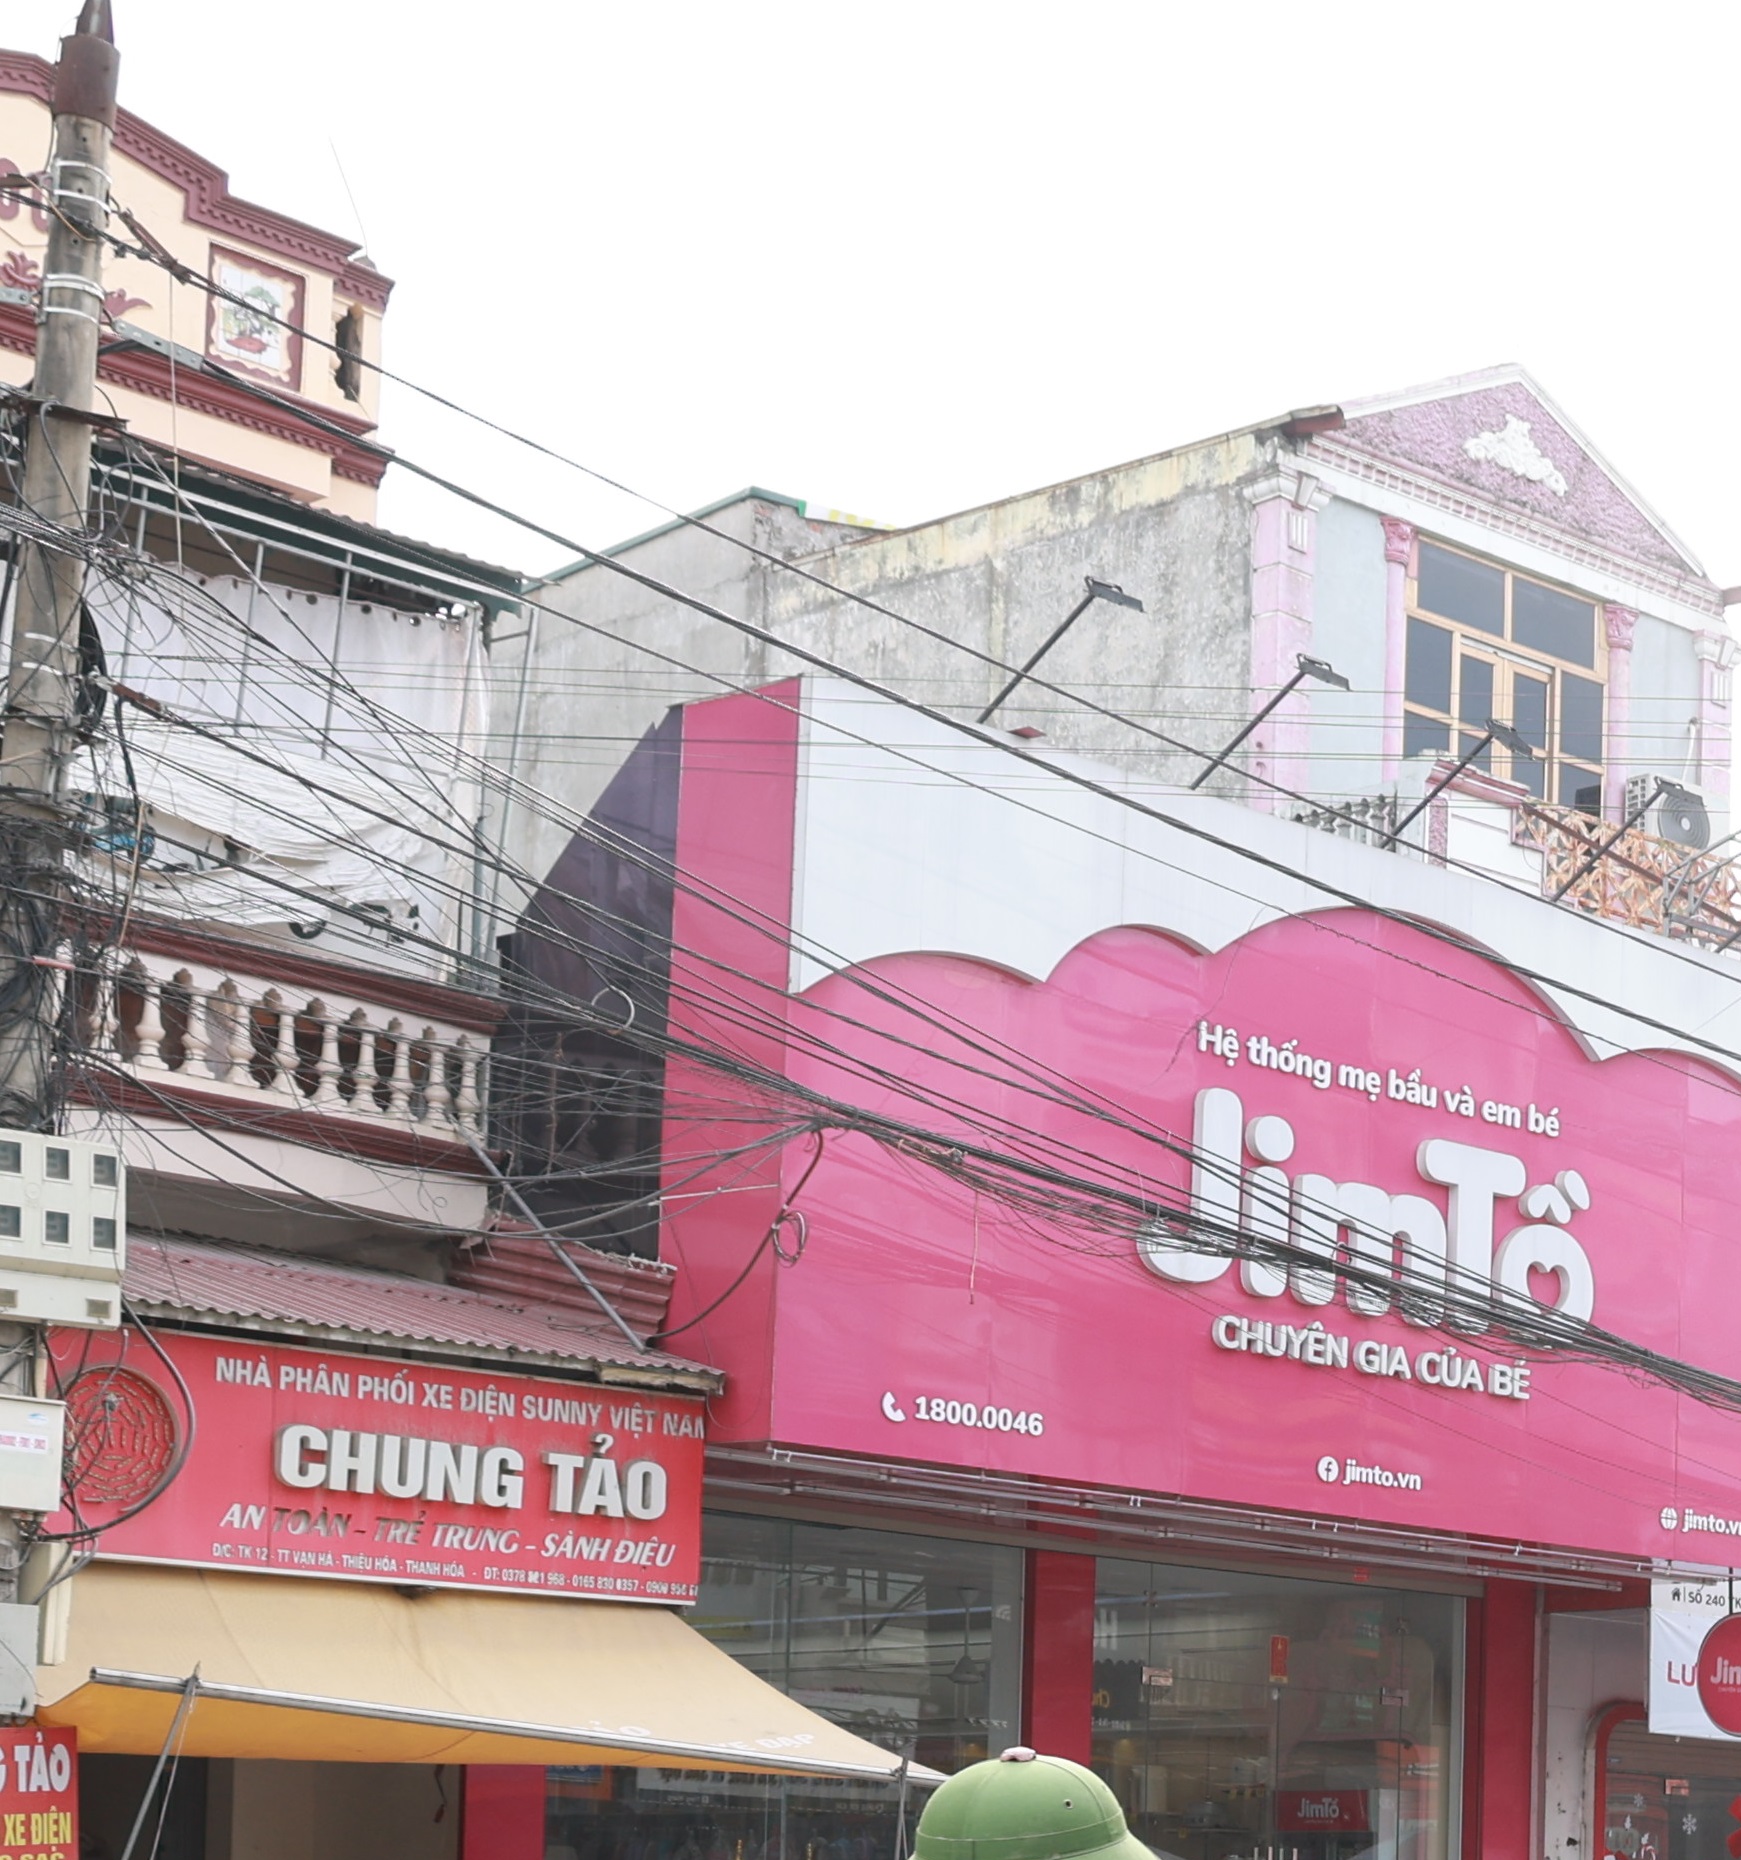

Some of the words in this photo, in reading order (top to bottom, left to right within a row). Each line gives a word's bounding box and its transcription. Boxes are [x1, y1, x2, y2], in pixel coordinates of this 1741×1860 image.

[1198, 1020, 1240, 1067] Hệ
[1246, 1035, 1332, 1090] thống
[1338, 1061, 1382, 1102] mẹ
[1387, 1068, 1438, 1109] bầu
[1443, 1086, 1476, 1118] và
[1481, 1099, 1522, 1129] em
[1526, 1103, 1560, 1138] bé
[1212, 1314, 1349, 1369] CHUYÊN
[1353, 1340, 1412, 1380] GIA
[1415, 1345, 1485, 1393] CỦA
[1488, 1360, 1531, 1401] BÉ
[215, 1355, 272, 1389] NHÀ
[279, 1363, 350, 1398] PHÂN
[357, 1368, 415, 1406] PHỐI
[422, 1382, 454, 1410] XE
[460, 1384, 515, 1423] ĐIỆN
[522, 1394, 603, 1427] SUNNY
[609, 1402, 659, 1440] VIỆT
[914, 1395, 1044, 1437] 1800.0046
[277, 1423, 525, 1510] CHUNG
[544, 1433, 668, 1521] TẢO
[1342, 1458, 1422, 1491] jimto.vn
[218, 1502, 267, 1531] AN
[272, 1506, 353, 1539] TOÀN
[372, 1510, 426, 1546] TRẺ
[432, 1521, 520, 1555] TRUNG
[540, 1530, 614, 1563] SÀNH
[614, 1536, 677, 1571] ĐIỆU
[238, 1545, 252, 1559] TK
[255, 1547, 269, 1561] 12
[277, 1549, 292, 1563] TT
[293, 1551, 316, 1569] VẠN
[341, 1553, 374, 1574] THIỆU
[375, 1554, 398, 1573] HÓA
[405, 1558, 441, 1576] THANH
[443, 1559, 466, 1578] HÓA
[484, 1566, 501, 1581] ĐT:
[1687, 1584, 1703, 1605] SỐ
[1705, 1591, 1726, 1608] 240
[14, 1731, 71, 1793] TẢO
[4, 1813, 26, 1847] XE
[30, 1805, 72, 1852] ĐIỆN
